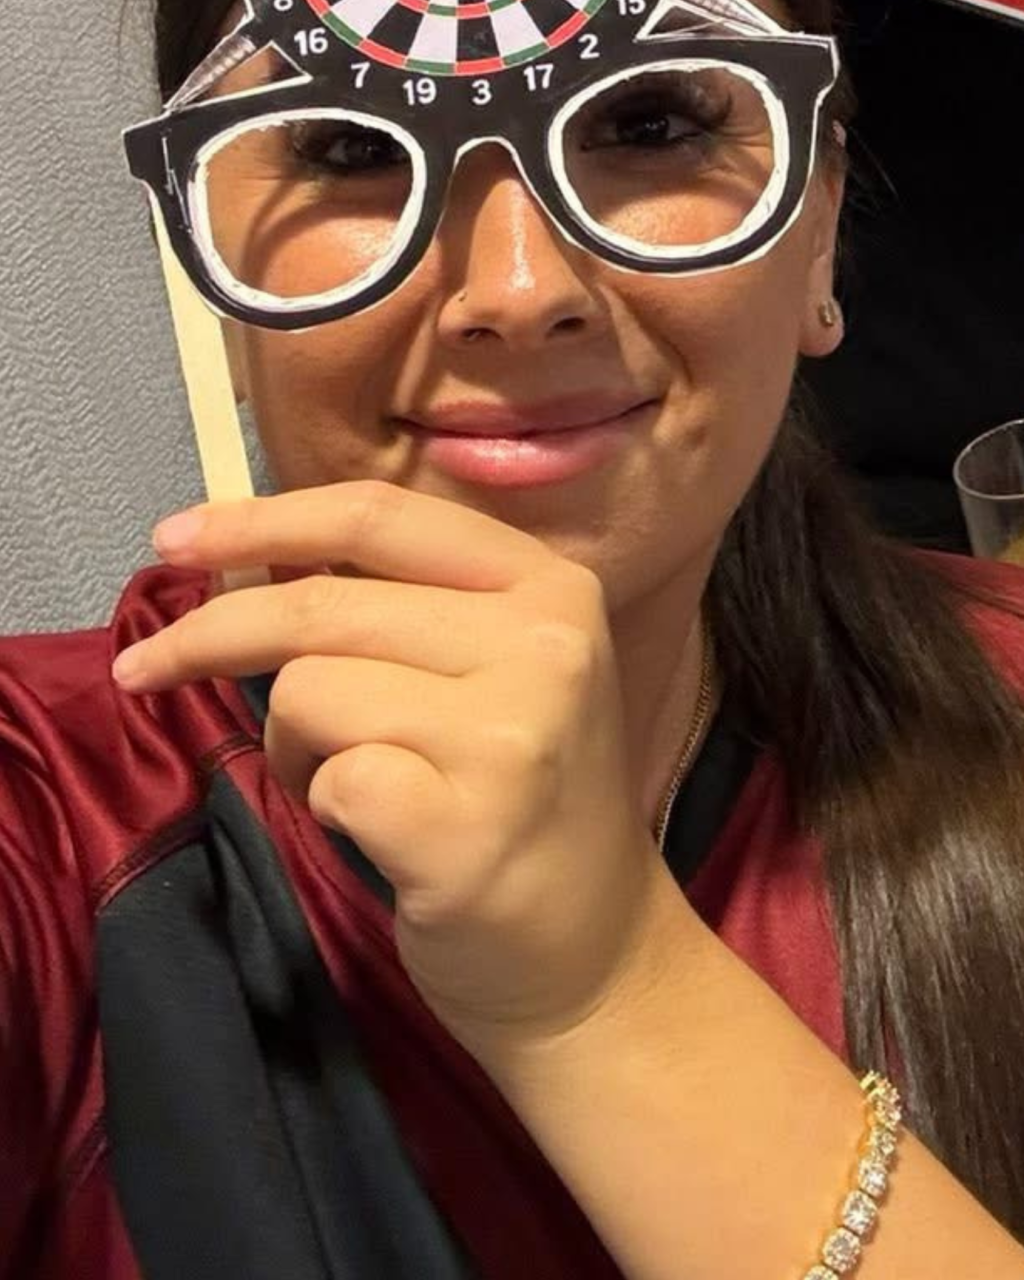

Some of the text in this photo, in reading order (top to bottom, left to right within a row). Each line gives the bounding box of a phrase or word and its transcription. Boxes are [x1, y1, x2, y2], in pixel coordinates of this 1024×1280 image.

[293, 27, 329, 57] 16
[578, 33, 600, 60] 2
[350, 61, 371, 89] 7
[523, 63, 554, 91] 17
[402, 77, 437, 106] 19
[471, 79, 492, 105] 3
